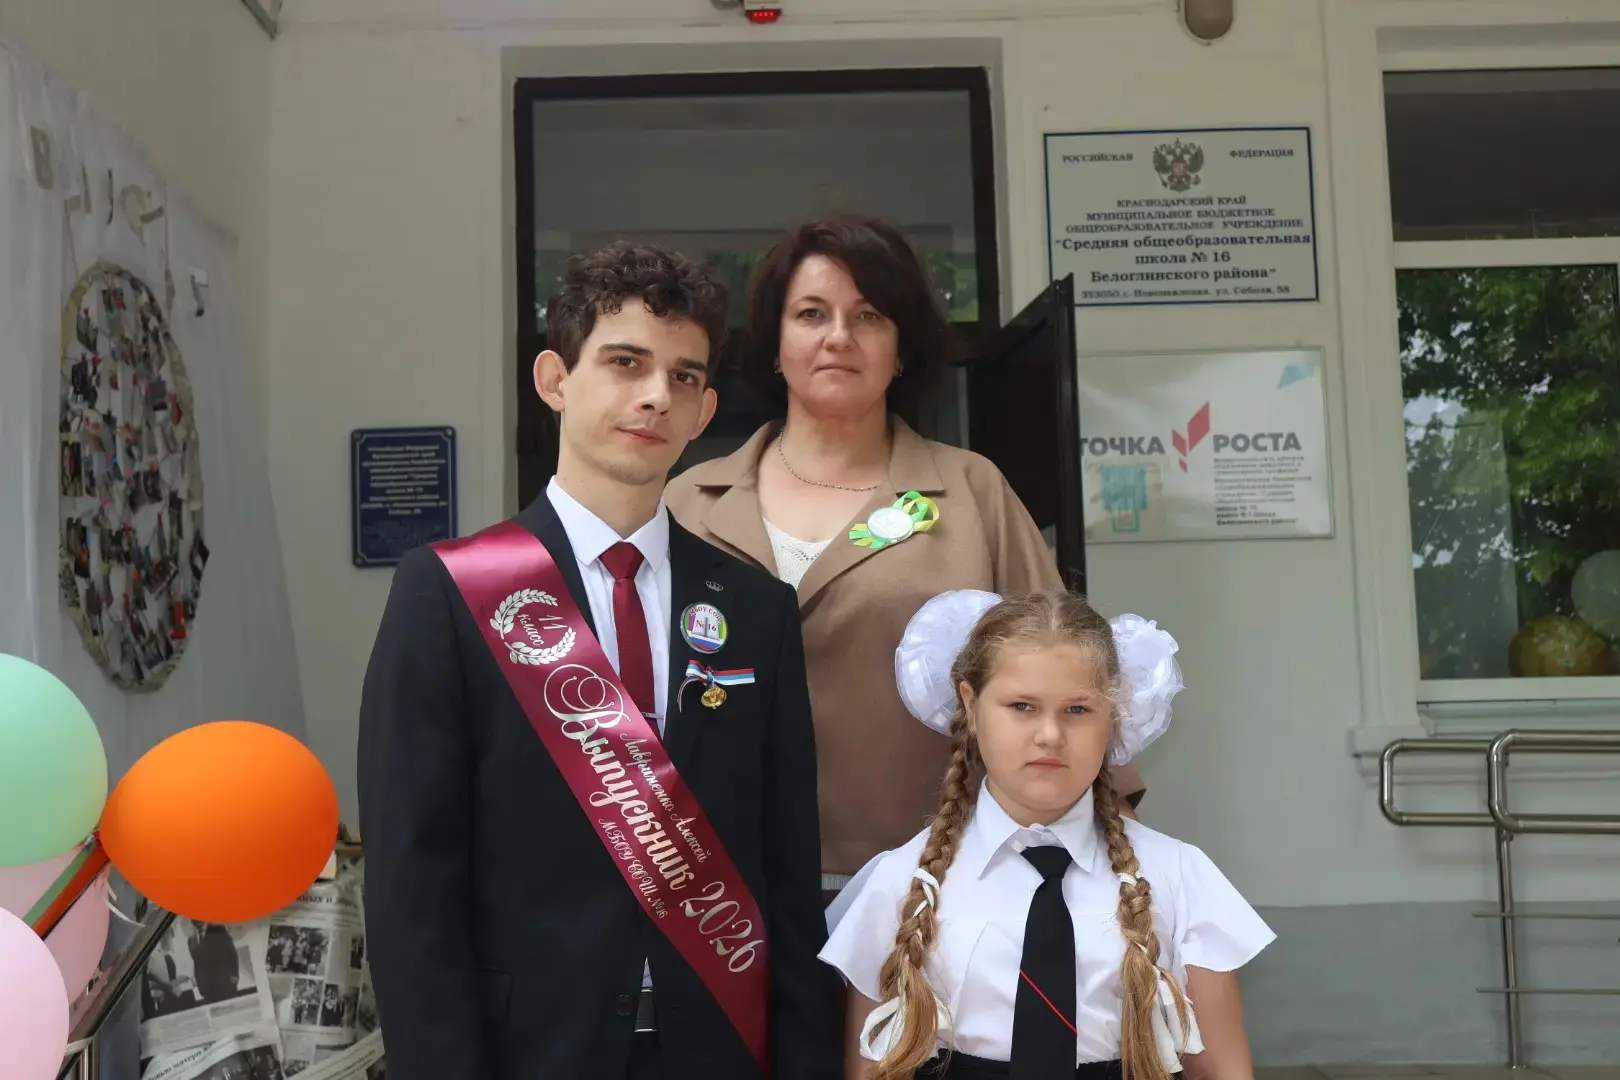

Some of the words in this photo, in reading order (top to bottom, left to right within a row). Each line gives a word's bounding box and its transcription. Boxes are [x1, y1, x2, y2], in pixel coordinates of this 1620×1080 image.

[1062, 152, 1134, 163] РОССИЙСКАЯ
[1229, 148, 1294, 159] ФЕДЕРАЦИЯ
[1116, 196, 1214, 208] КРАСНОДАРСКИЙ
[1217, 195, 1247, 206] КРАЙ
[1086, 209, 1192, 222] МУНИЦИПАЛЬНОЕ
[1196, 208, 1276, 219] БЮДЖЕТНОЕ
[1065, 220, 1215, 234] ОБЩЕОБРАЗОВАТЕЛЬНОЕ
[1222, 218, 1304, 230] УЧРЕЖДЕНИЕ
[1133, 233, 1311, 249] общеобразовательная
[1135, 252, 1187, 265] школа
[1190, 252, 1208, 264] №
[1213, 251, 1231, 263] 16
[1090, 270, 1210, 283] Белоглинского
[1080, 436, 1166, 456] ТОЧКА
[1212, 432, 1302, 453] РОСТА
[516, 613, 544, 646] класс
[538, 614, 568, 629] 11
[543, 664, 695, 891] Выпускник
[679, 881, 765, 973] 2026
[670, 813, 712, 863] Алексей
[598, 818, 636, 861] МБОУ
[627, 859, 659, 898] СОШ
